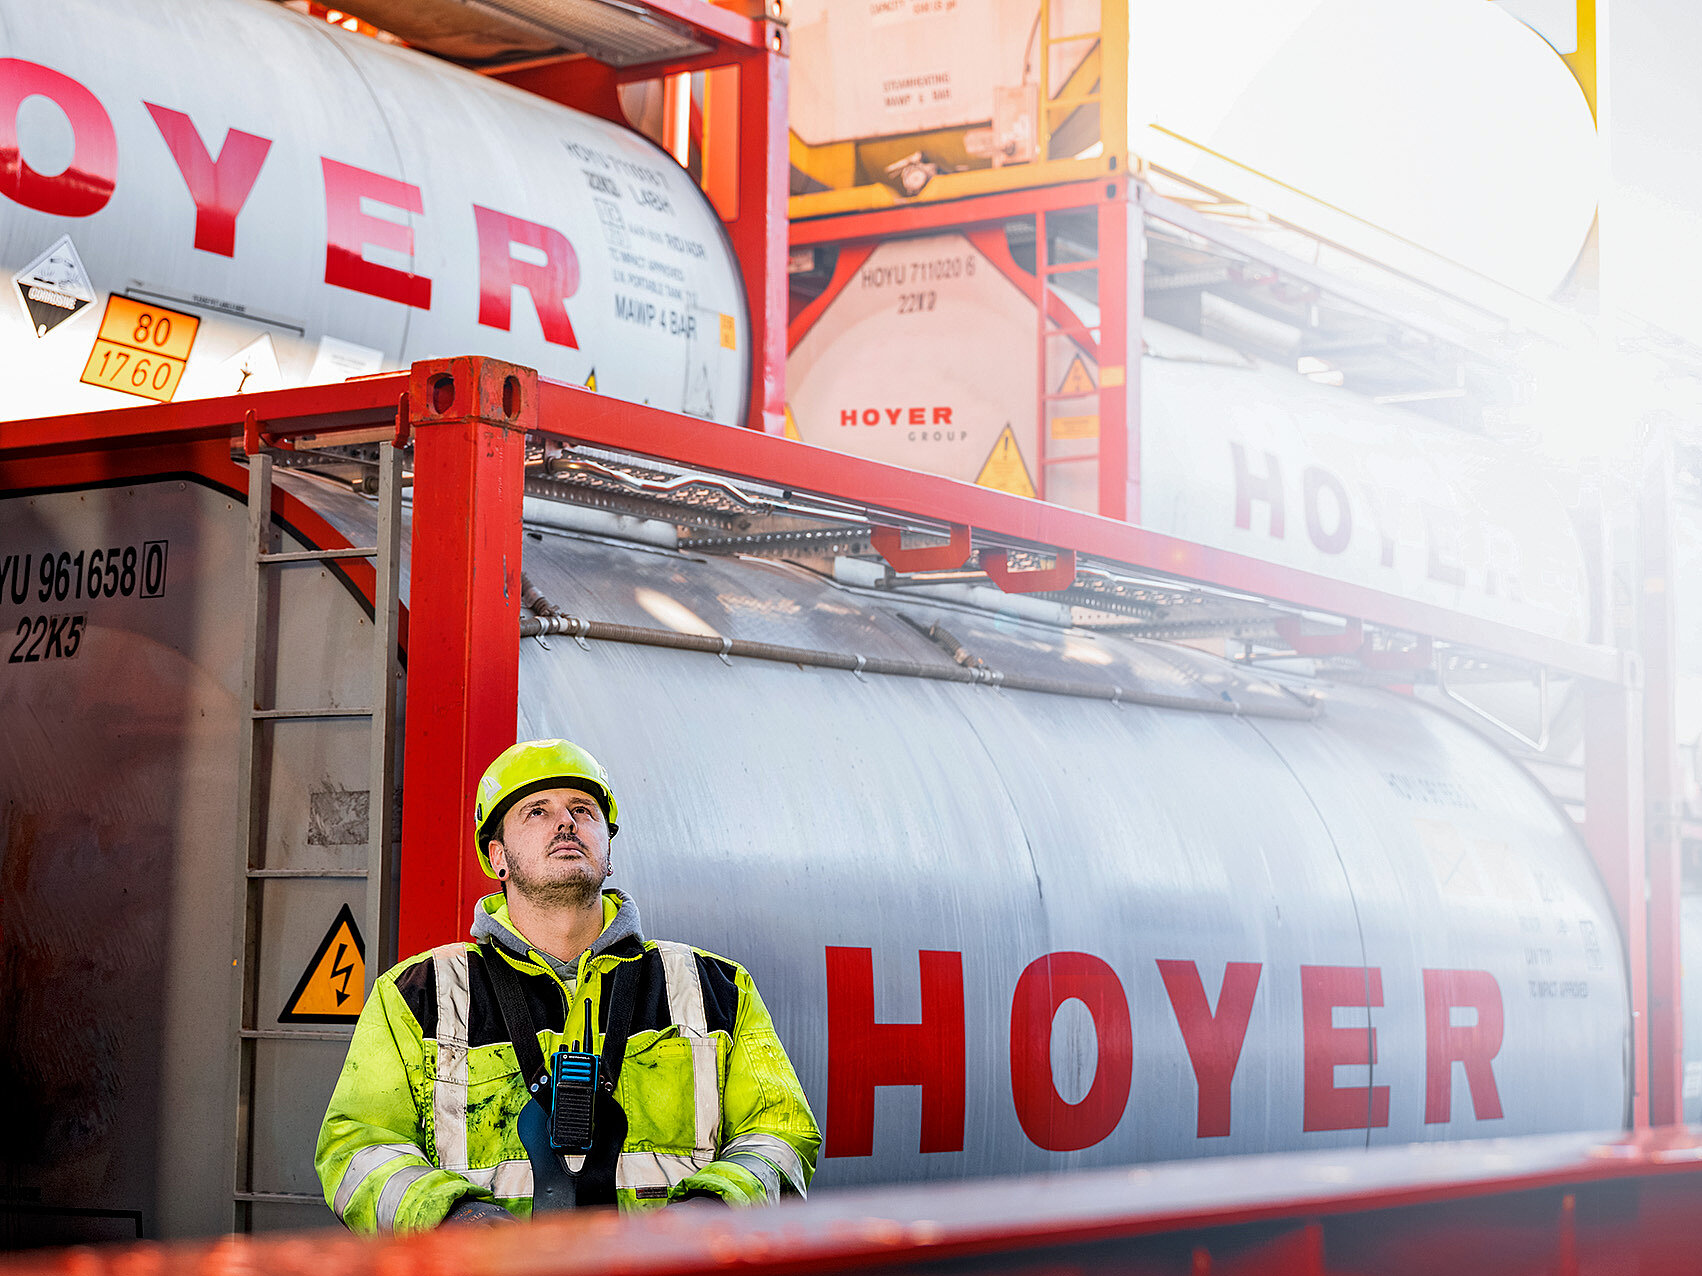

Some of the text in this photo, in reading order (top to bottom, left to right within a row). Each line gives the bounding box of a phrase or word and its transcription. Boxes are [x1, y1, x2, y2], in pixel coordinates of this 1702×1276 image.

[861, 263, 906, 289] HOYU
[133, 313, 171, 347] 80
[98, 350, 172, 391] 1760
[840, 406, 953, 426] HOYER
[908, 431, 968, 441] GROUP
[8, 615, 84, 664] 22K5
[824, 945, 1505, 1159] HOYER
